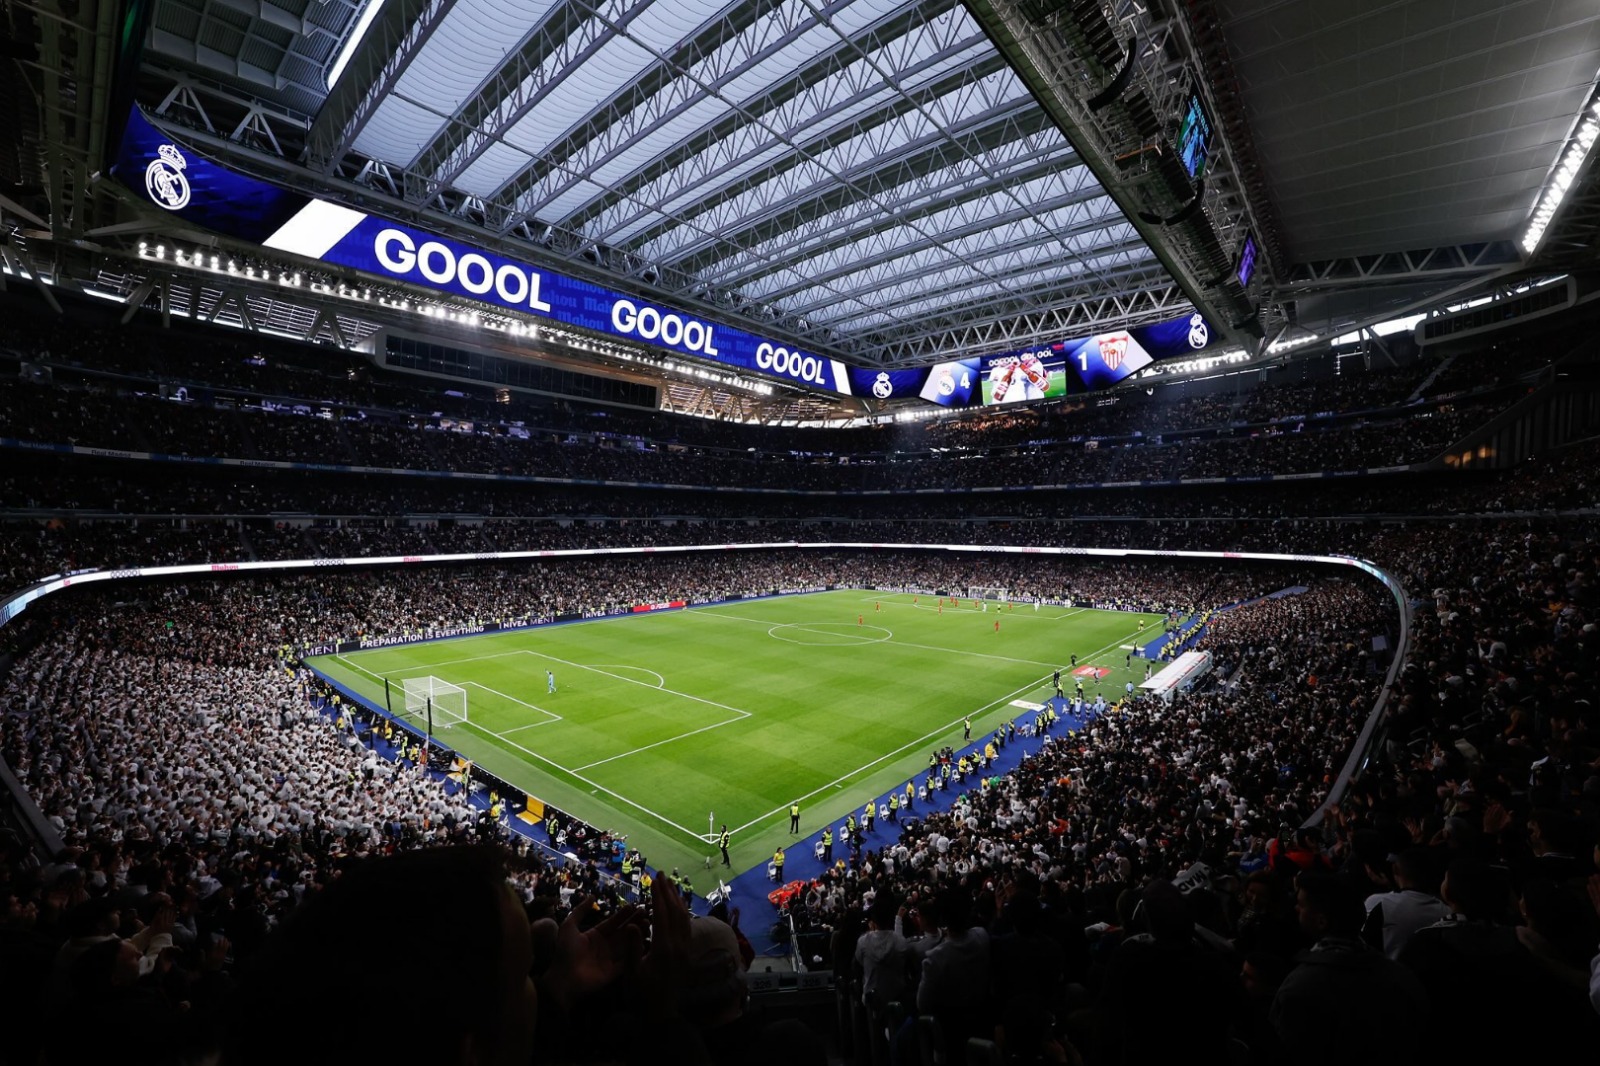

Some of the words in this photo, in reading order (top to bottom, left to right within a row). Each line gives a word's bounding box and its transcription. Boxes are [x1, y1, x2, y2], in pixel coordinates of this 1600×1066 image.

[374, 228, 550, 313] GOOOL
[612, 299, 718, 357] GOOOL
[756, 342, 825, 385] GOOOL
[1077, 351, 1088, 371] 1
[960, 371, 971, 389] 4
[503, 620, 527, 629] NIVEA
[530, 617, 550, 626] MEN
[585, 610, 606, 619] NIVEA
[608, 608, 625, 616] MEN
[360, 632, 423, 649] PREPARATION
[425, 631, 433, 640] IS
[435, 625, 484, 639] EVERYTHING
[305, 645, 333, 657] MEN
